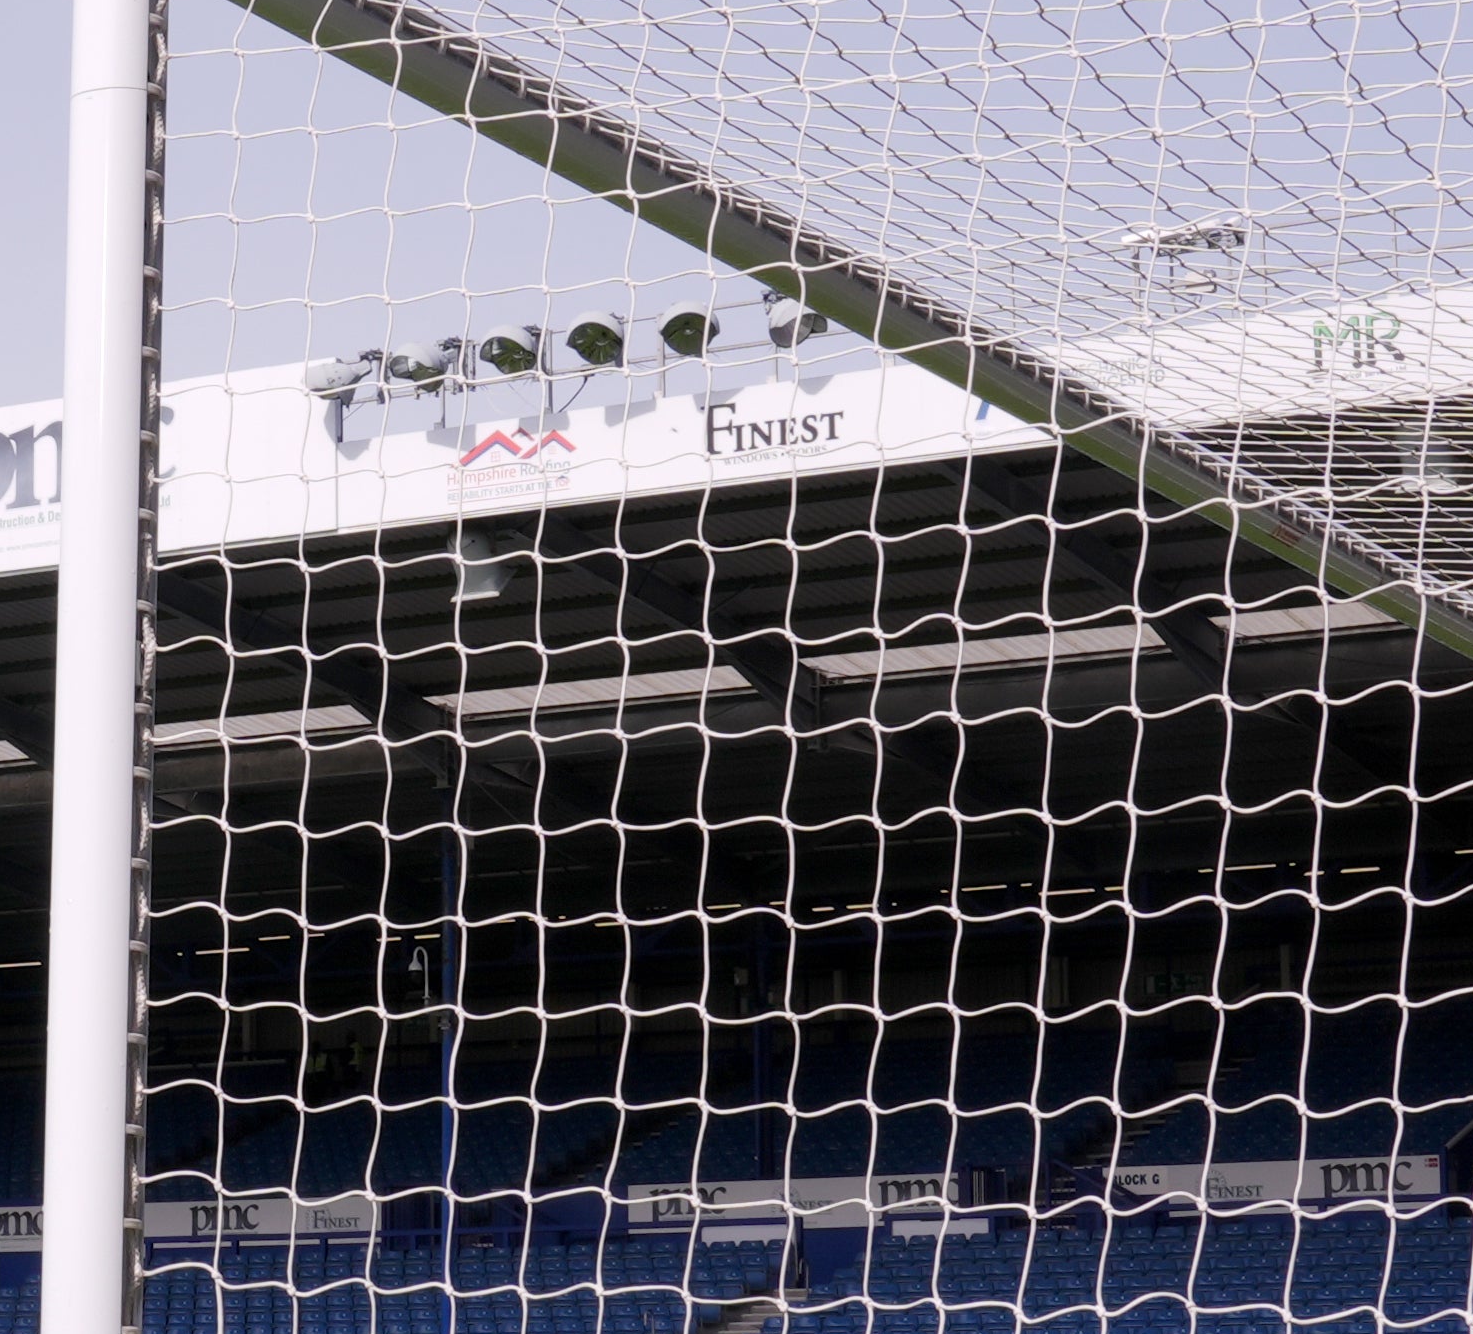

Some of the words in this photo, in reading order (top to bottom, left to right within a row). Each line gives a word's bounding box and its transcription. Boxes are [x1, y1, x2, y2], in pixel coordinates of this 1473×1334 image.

[1312, 312, 1405, 371] MR
[700, 403, 844, 455] FINEST
[520, 460, 571, 477] Rofing
[724, 452, 778, 466] WINDOWS
[1152, 1172, 1161, 1185] G
[1320, 1161, 1413, 1198] pmc
[190, 1203, 260, 1236] pmc
[312, 1209, 361, 1230] FINEST
[650, 1186, 726, 1221] pmc
